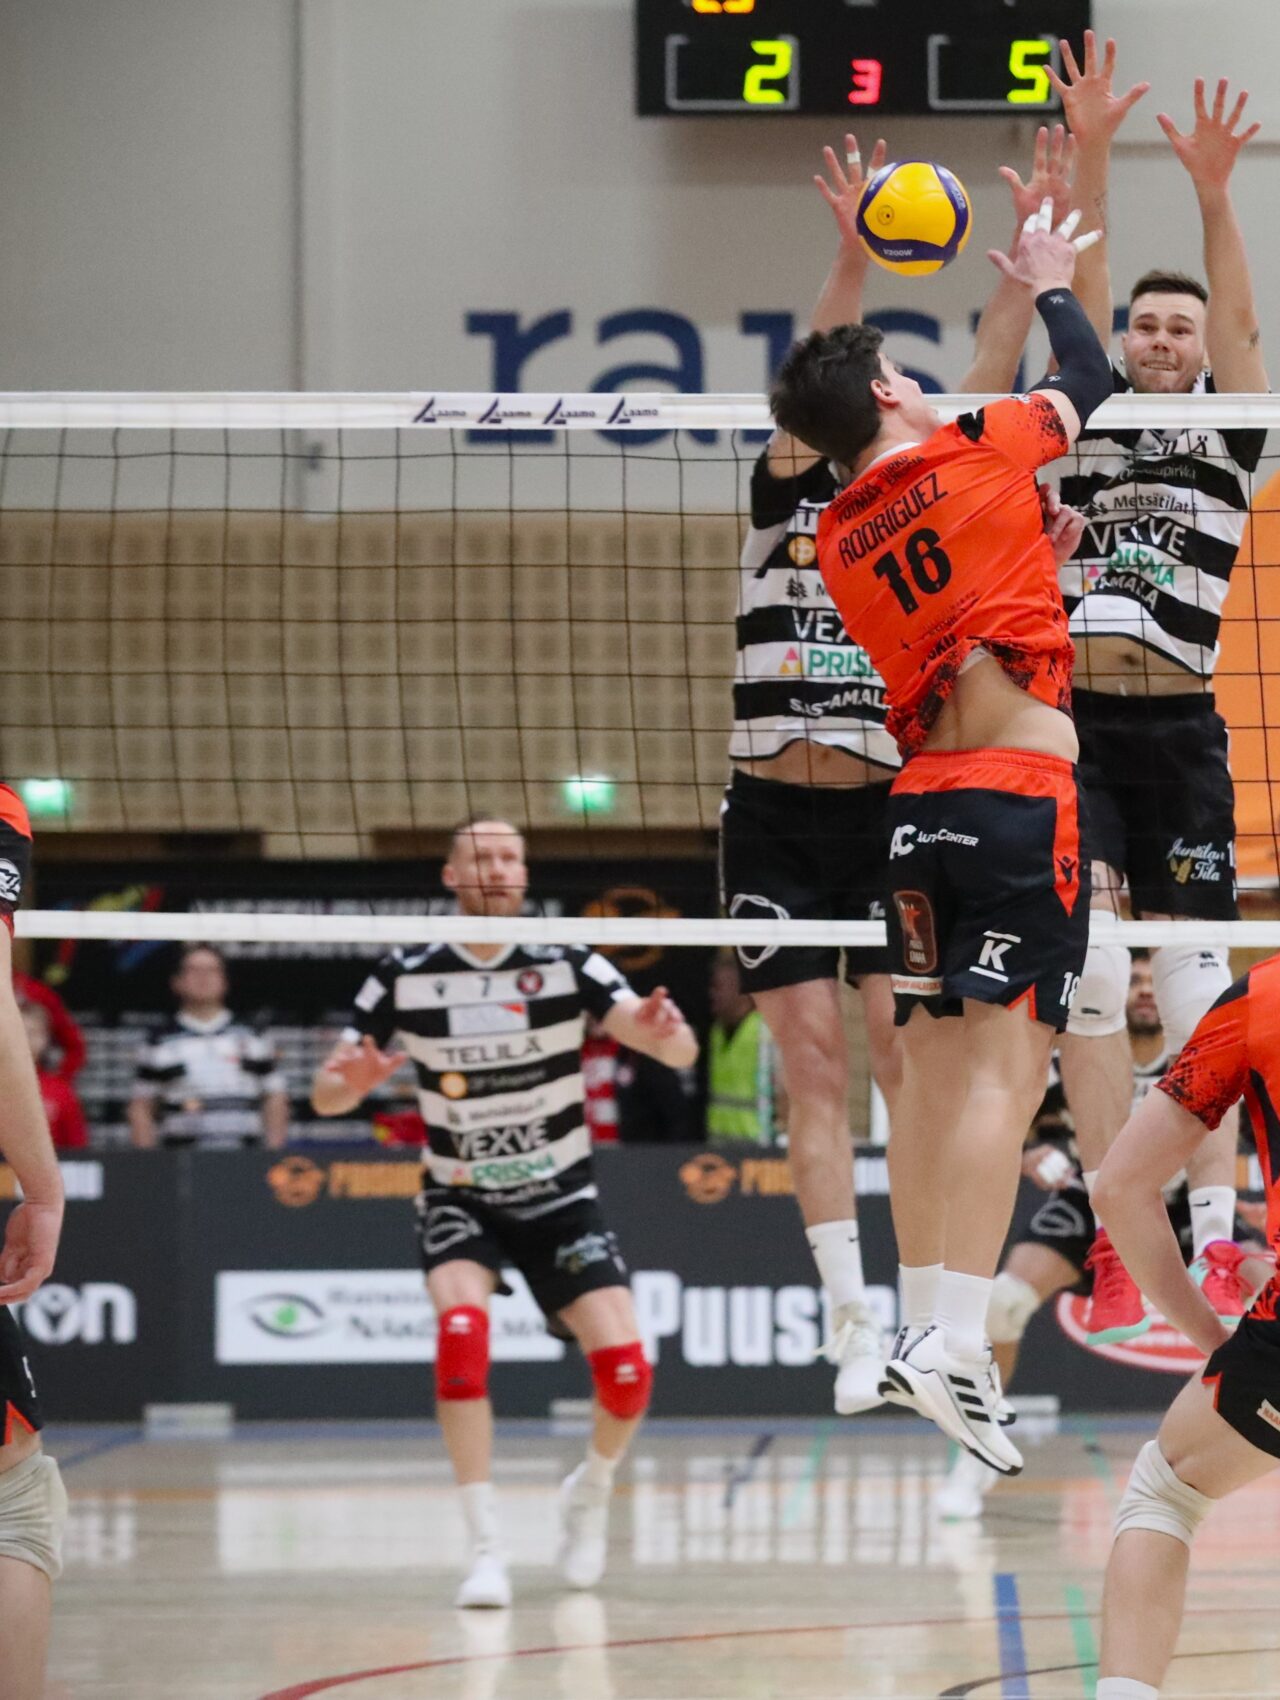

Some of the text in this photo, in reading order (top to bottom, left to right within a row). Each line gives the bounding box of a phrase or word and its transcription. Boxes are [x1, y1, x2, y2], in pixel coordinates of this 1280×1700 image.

[743, 40, 792, 104] 2
[848, 59, 882, 104] 3
[1007, 40, 1051, 104] 5
